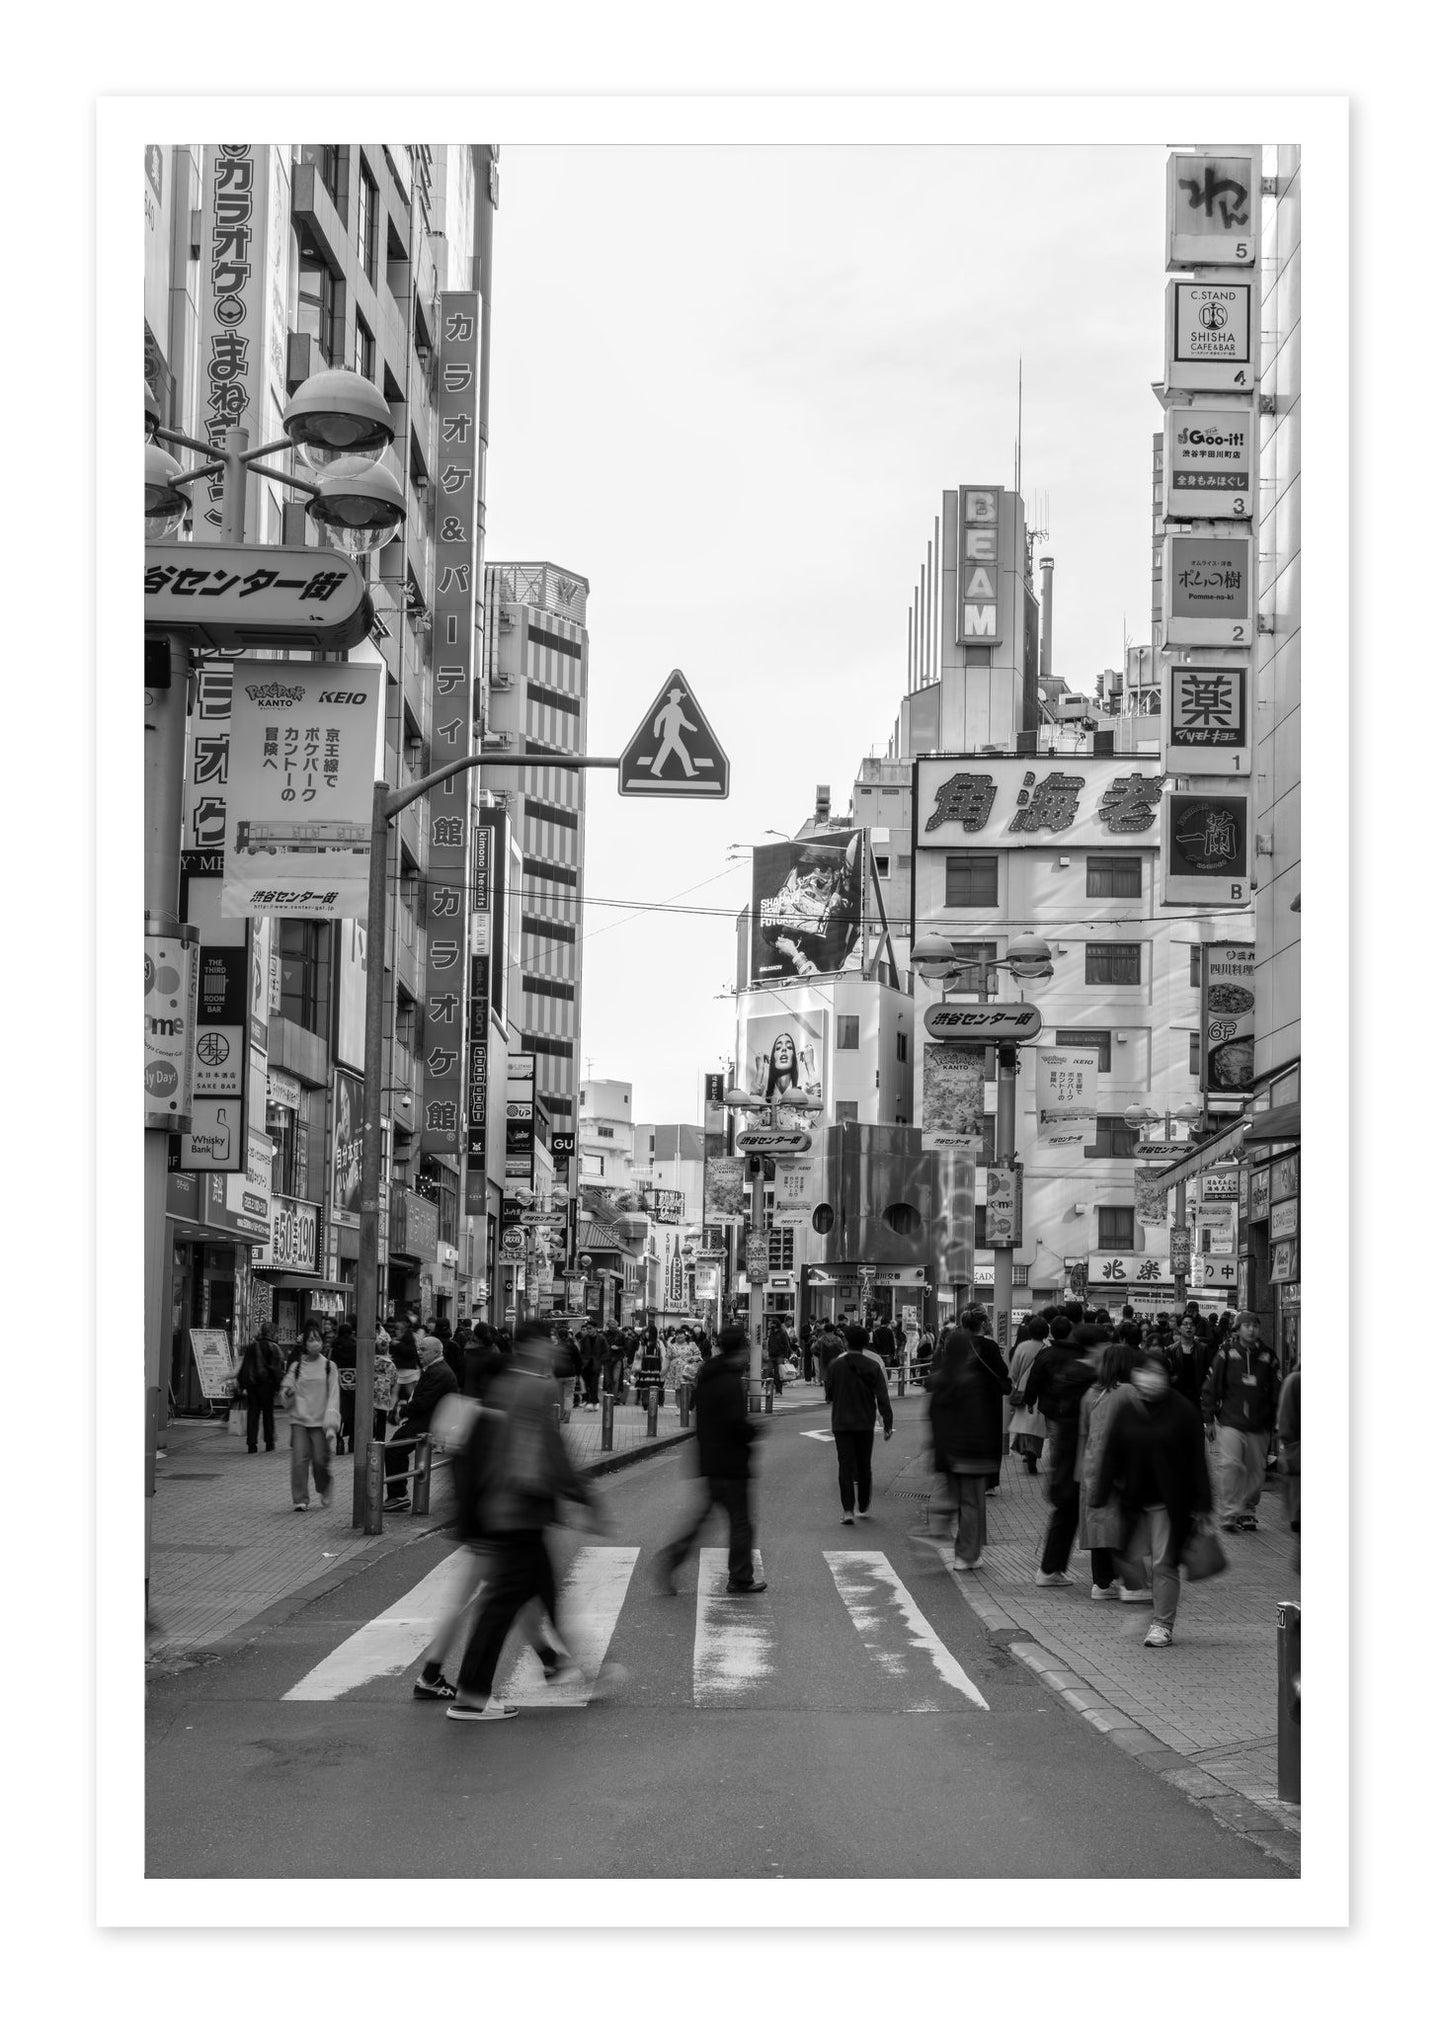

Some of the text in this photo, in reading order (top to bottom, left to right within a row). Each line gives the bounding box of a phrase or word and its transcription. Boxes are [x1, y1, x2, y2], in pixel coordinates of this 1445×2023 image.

[211, 157, 253, 297] カラオケ
[1235, 243, 1248, 259] 5
[1190, 290, 1237, 302] C.STAND
[1190, 331, 1236, 343] SHISHA
[1190, 343, 1236, 352] CAFE&BAR
[1189, 430, 1244, 446] Goo-it!
[1182, 449, 1241, 459] 渋谷宇田川町店
[1176, 475, 1246, 487] 全身もみほぐし
[1233, 498, 1245, 515] 3
[963, 492, 998, 637] BEAM
[1232, 626, 1244, 642] 2
[318, 691, 367, 705] KEIO
[1181, 674, 1232, 726] 薬
[262, 726, 279, 770] 冒険へ
[280, 727, 299, 802] カントーの
[323, 727, 341, 788] 京王線で
[1232, 754, 1241, 771] 1
[1176, 811, 1237, 860] 一蘭
[477, 831, 488, 907] kimono hearts
[249, 890, 339, 904] 渋谷センター街
[1230, 883, 1243, 900] B
[204, 966, 227, 974] THIRD
[208, 959, 223, 967] THE
[203, 995, 225, 1003] ROOM
[207, 1005, 222, 1013] BAR
[426, 887, 461, 1133] カラオケ館
[931, 1012, 1035, 1027] 渋谷センター街
[1208, 1021, 1238, 1042] 6F
[196, 1082, 237, 1090] SAKE BAR
[191, 1135, 226, 1147] Whisky
[553, 1138, 574, 1150] GU
[191, 1145, 212, 1154] Bank
[1102, 1258, 1162, 1281] 兆楽
[672, 1257, 681, 1300] BEER
